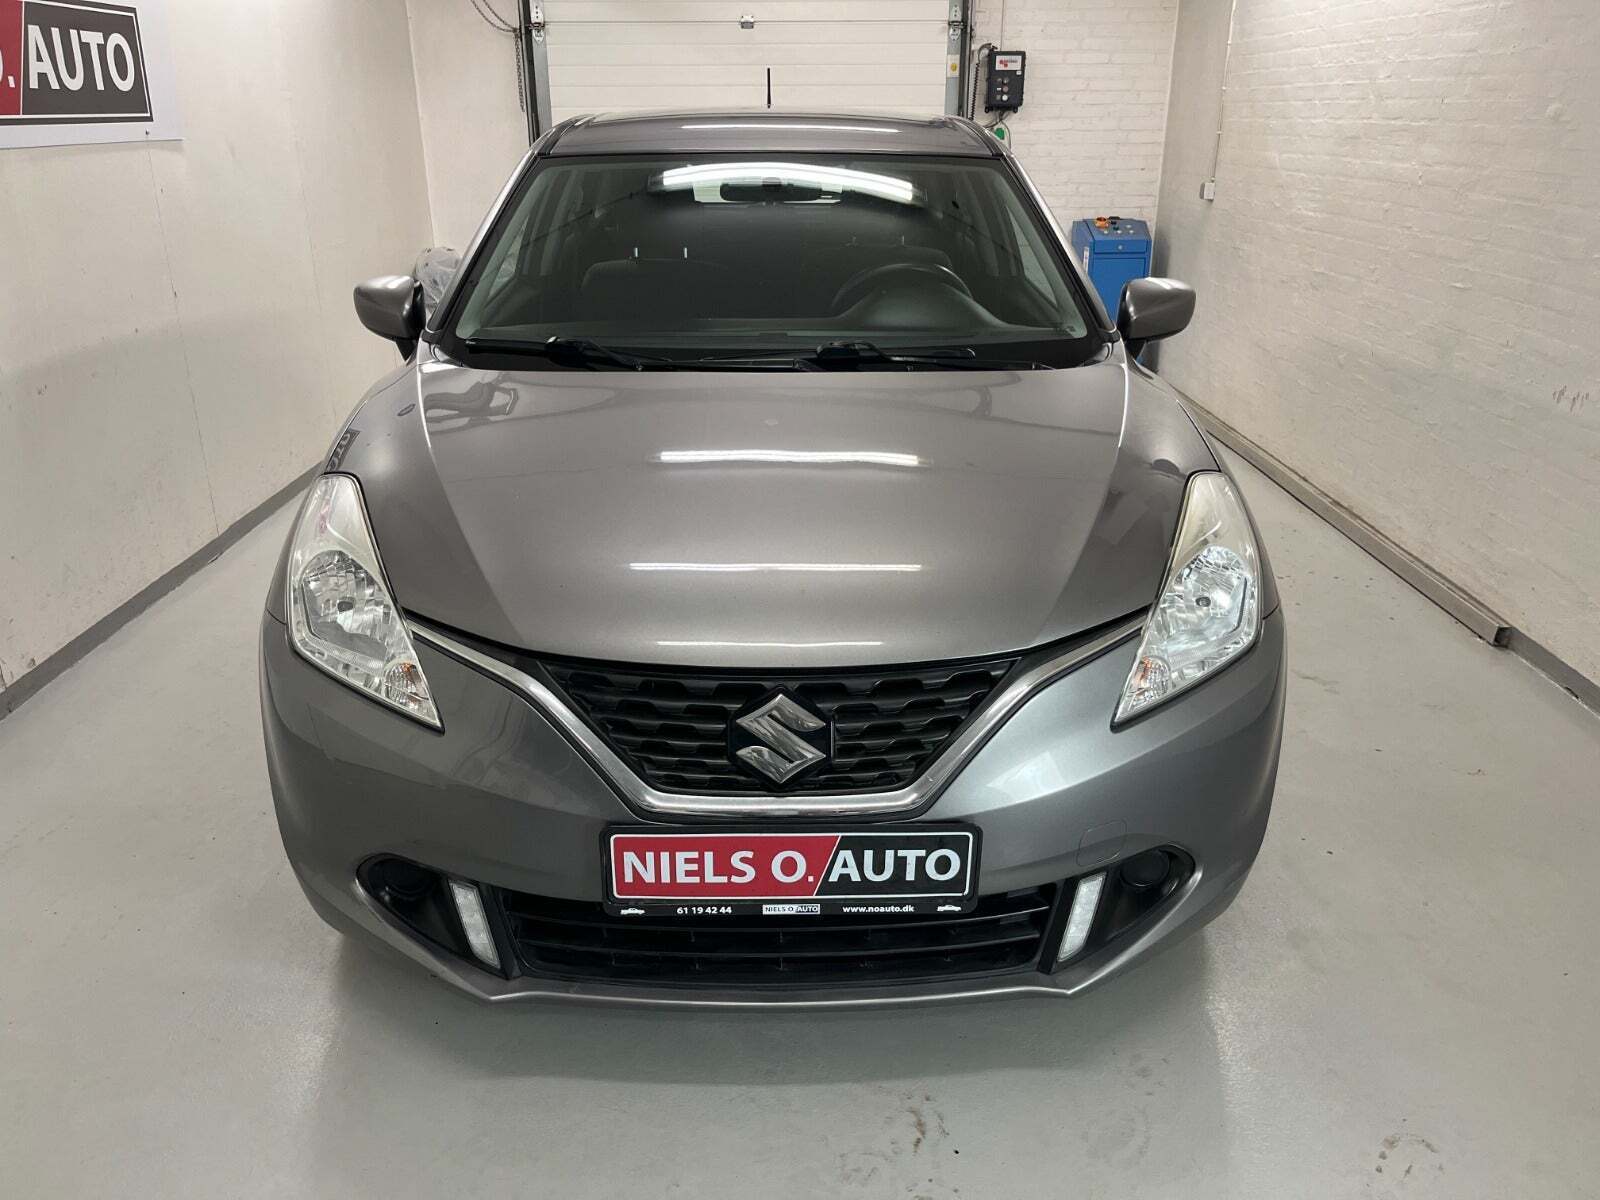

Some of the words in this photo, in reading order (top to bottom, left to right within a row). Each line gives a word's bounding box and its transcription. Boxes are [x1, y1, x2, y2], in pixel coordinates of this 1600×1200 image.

[27, 24, 135, 91] AUTO
[623, 851, 756, 883] NIELS
[771, 851, 814, 883] O.
[828, 849, 961, 882] AUTO
[676, 906, 689, 914] 61
[691, 906, 703, 914] 19
[705, 906, 717, 914] 42
[719, 906, 732, 914] 44
